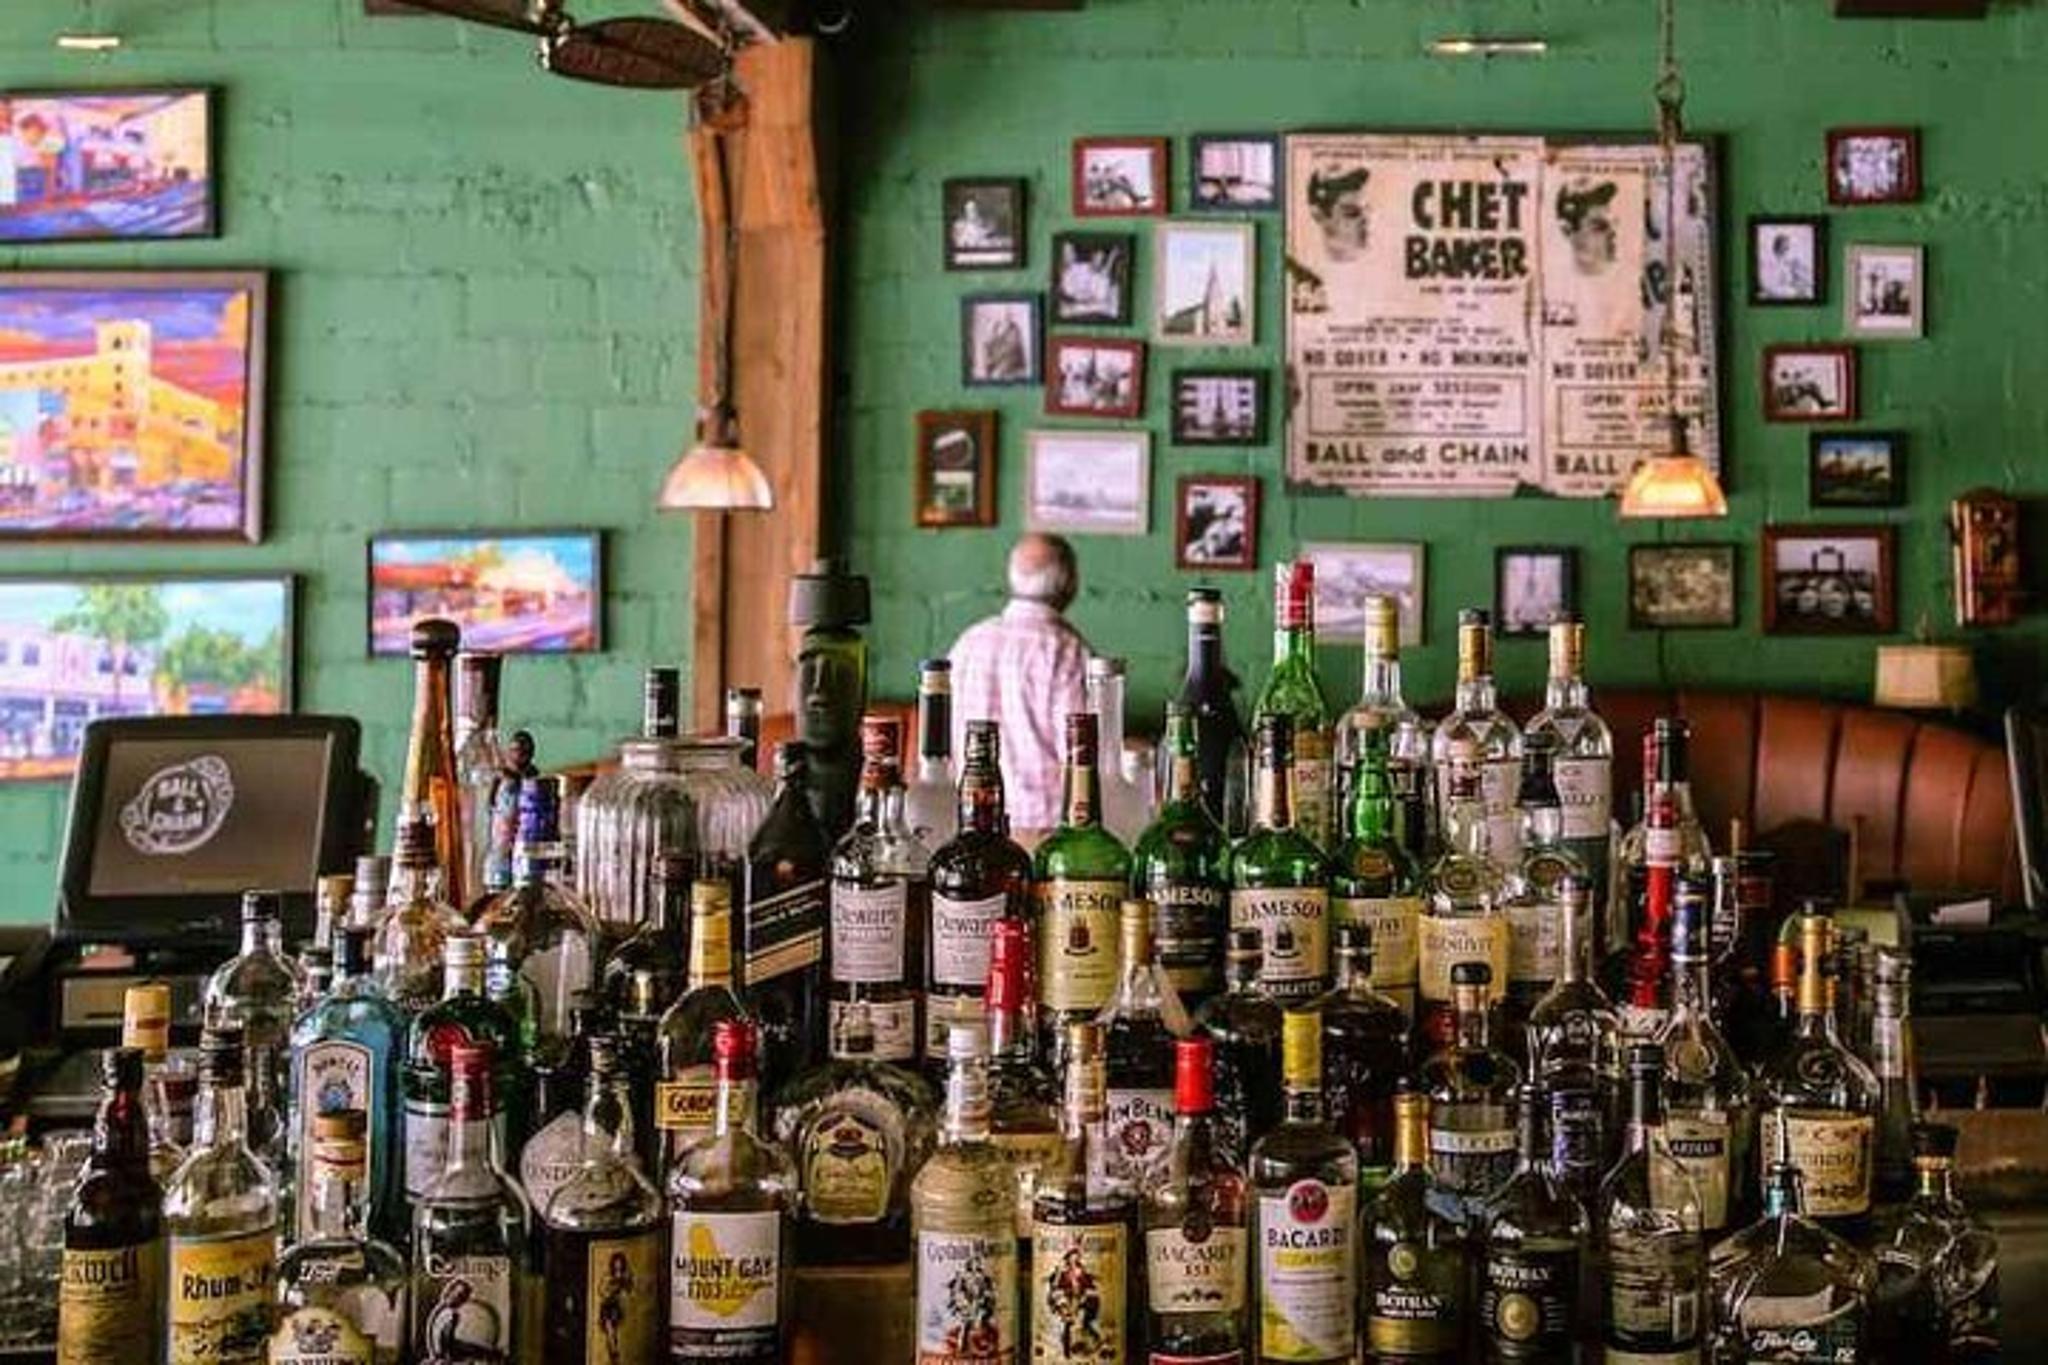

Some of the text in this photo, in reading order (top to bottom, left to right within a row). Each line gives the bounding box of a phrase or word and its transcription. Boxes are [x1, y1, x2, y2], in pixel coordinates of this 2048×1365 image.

[1412, 181, 1528, 231] CHET
[1405, 236, 1528, 281] BAKER
[1304, 350, 1528, 367] NO COVER NO MINIMUM
[1554, 363, 1574, 378] NO
[1306, 442, 1529, 464] BALL and CHAIN
[1555, 454, 1619, 475] BALL
[157, 777, 199, 799] BALL
[676, 1256, 772, 1278] MOUNT GAY
[183, 1272, 241, 1301] Rhum
